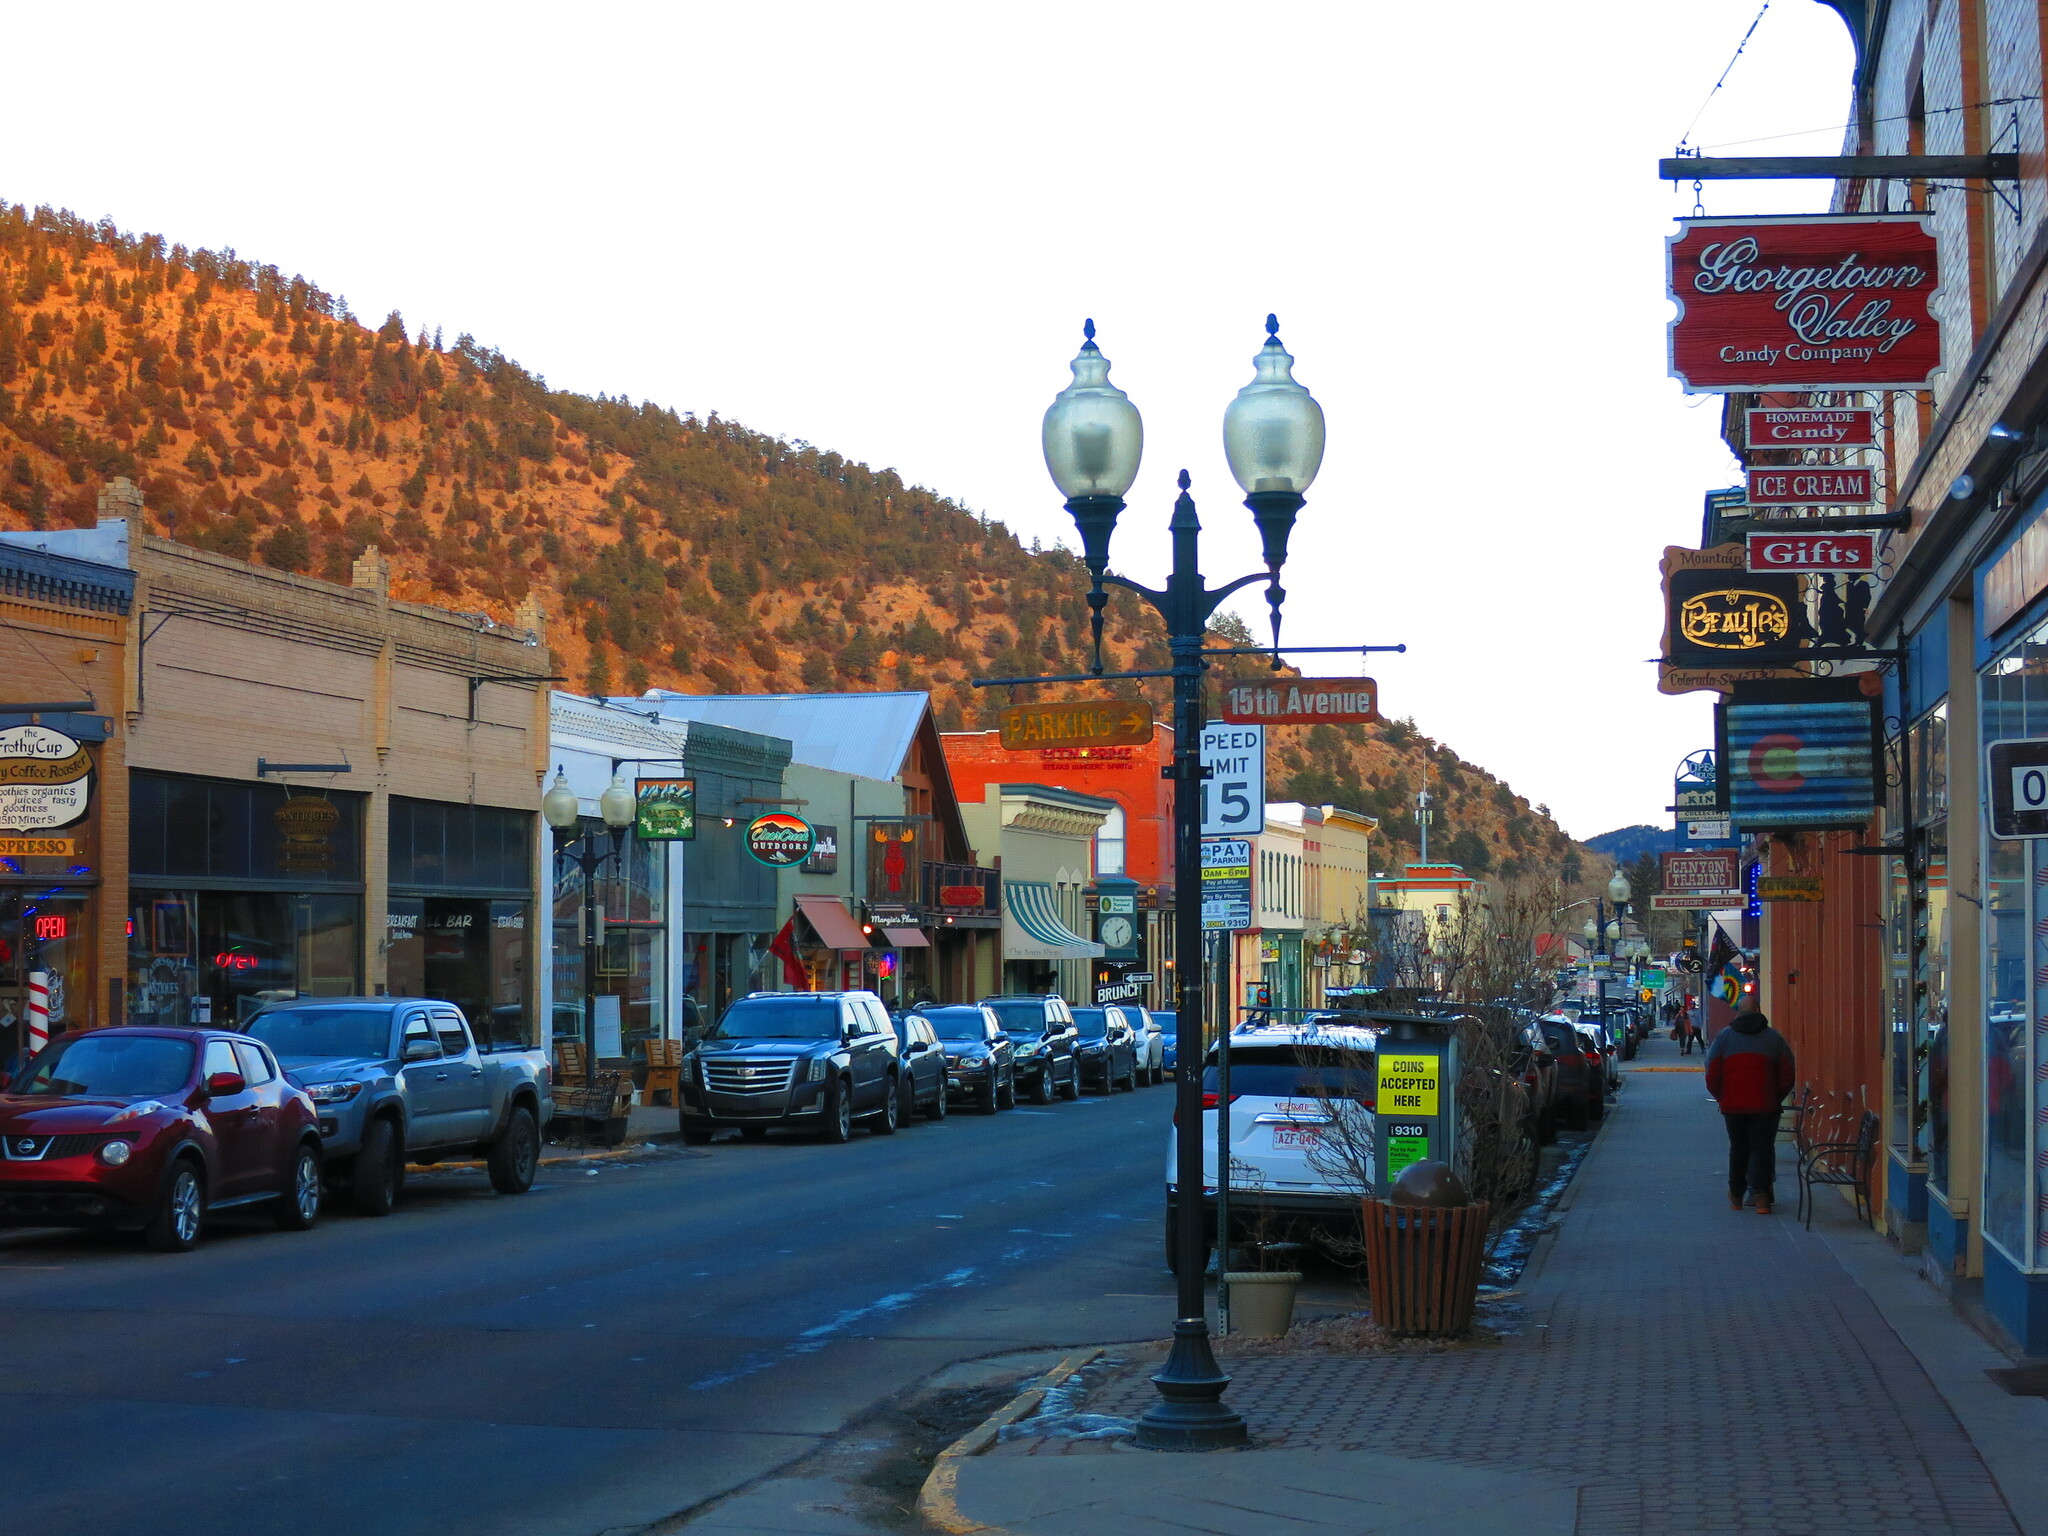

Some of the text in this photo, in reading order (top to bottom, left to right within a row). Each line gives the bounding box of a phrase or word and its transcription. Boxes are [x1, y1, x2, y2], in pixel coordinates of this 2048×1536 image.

[1694, 237, 1927, 310] Georgetown
[1789, 293, 1917, 353] Valley
[1719, 343, 1874, 366] Candy Company
[1765, 412, 1855, 423] HOMEMADE
[1771, 424, 1848, 441] Candy
[1756, 476, 1864, 496] ICE CREAM
[1763, 540, 1860, 564] Gifts
[1680, 551, 1742, 567] Mountain
[1726, 588, 1740, 605] by
[1229, 687, 1370, 715] 15th Avenue
[1007, 709, 1112, 741] PARKING
[24, 728, 38, 738] the
[0, 737, 35, 756] rothy
[1200, 732, 1257, 750] PEED
[10, 765, 47, 778] Coffee
[49, 755, 86, 778] Roaster
[1210, 757, 1249, 774] IMIT
[32, 786, 76, 798] organics
[12, 796, 77, 806] juices tasty
[2, 805, 48, 815] goodness
[279, 811, 336, 821] ANTIQUES
[18, 816, 47, 825] Miner
[752, 842, 808, 850] OUTDOORS
[1212, 843, 1247, 856] PAY
[1212, 856, 1248, 865] PARKING
[1672, 860, 1725, 874] CANYON
[1672, 873, 1726, 886] TRADING
[1664, 898, 1703, 906] CLOTHING
[446, 914, 473, 928] BAR
[871, 914, 919, 926] Margie's Place
[1227, 919, 1248, 927] 9310
[36, 917, 65, 938] OPEN
[215, 952, 258, 969] OPEN
[1098, 983, 1141, 1003] BRUNCH
[1393, 1061, 1425, 1073] COINS
[1380, 1078, 1436, 1090] ACCEPTED
[1278, 1102, 1317, 1112] GMC
[1393, 1095, 1421, 1107] HERE
[1395, 1126, 1423, 1136] 9310
